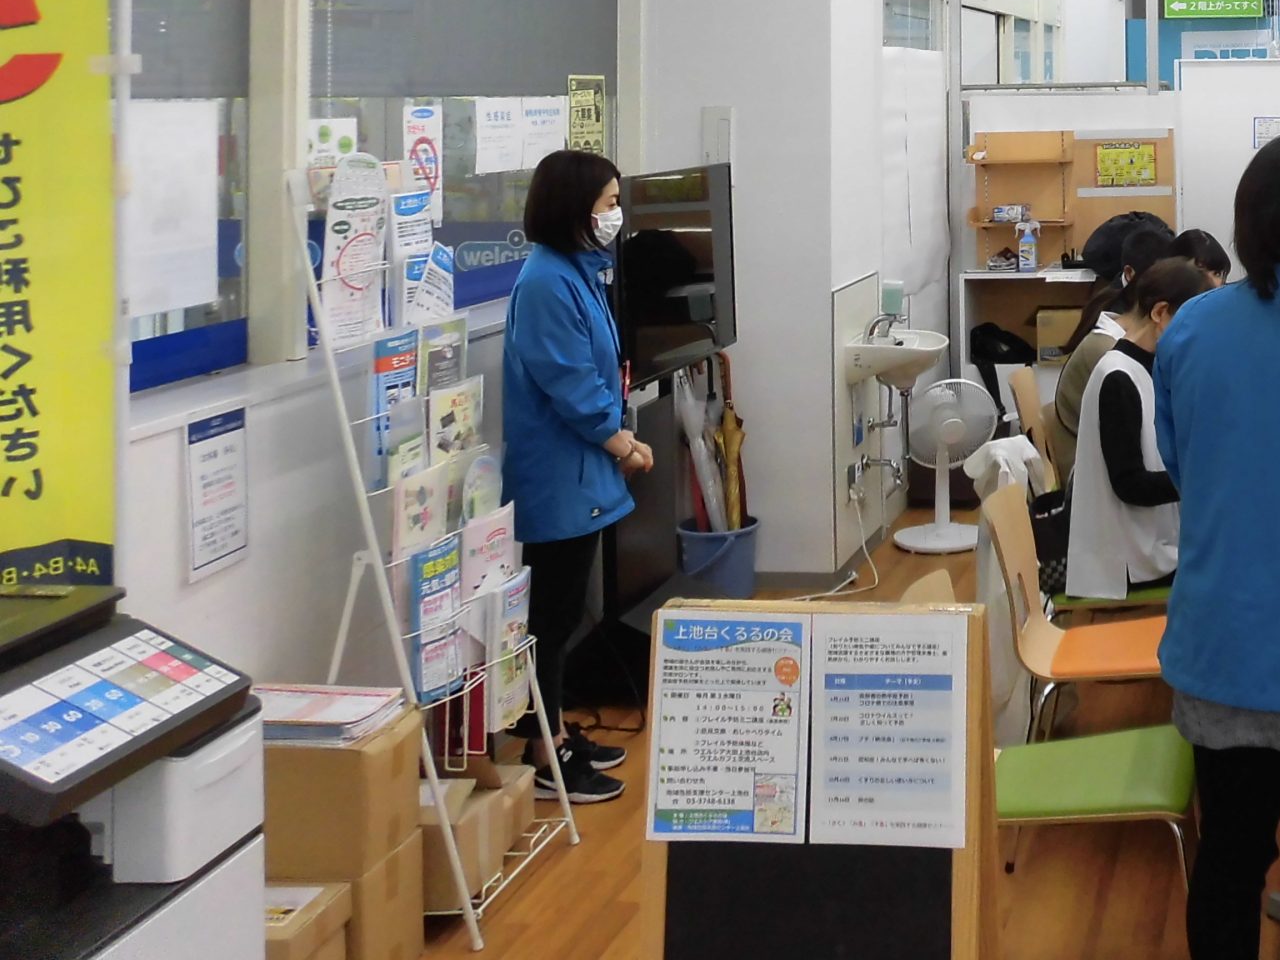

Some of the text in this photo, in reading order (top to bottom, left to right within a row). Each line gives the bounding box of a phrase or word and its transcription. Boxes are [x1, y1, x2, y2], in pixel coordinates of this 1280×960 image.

[674, 625, 794, 642] 上池台くるるの会
